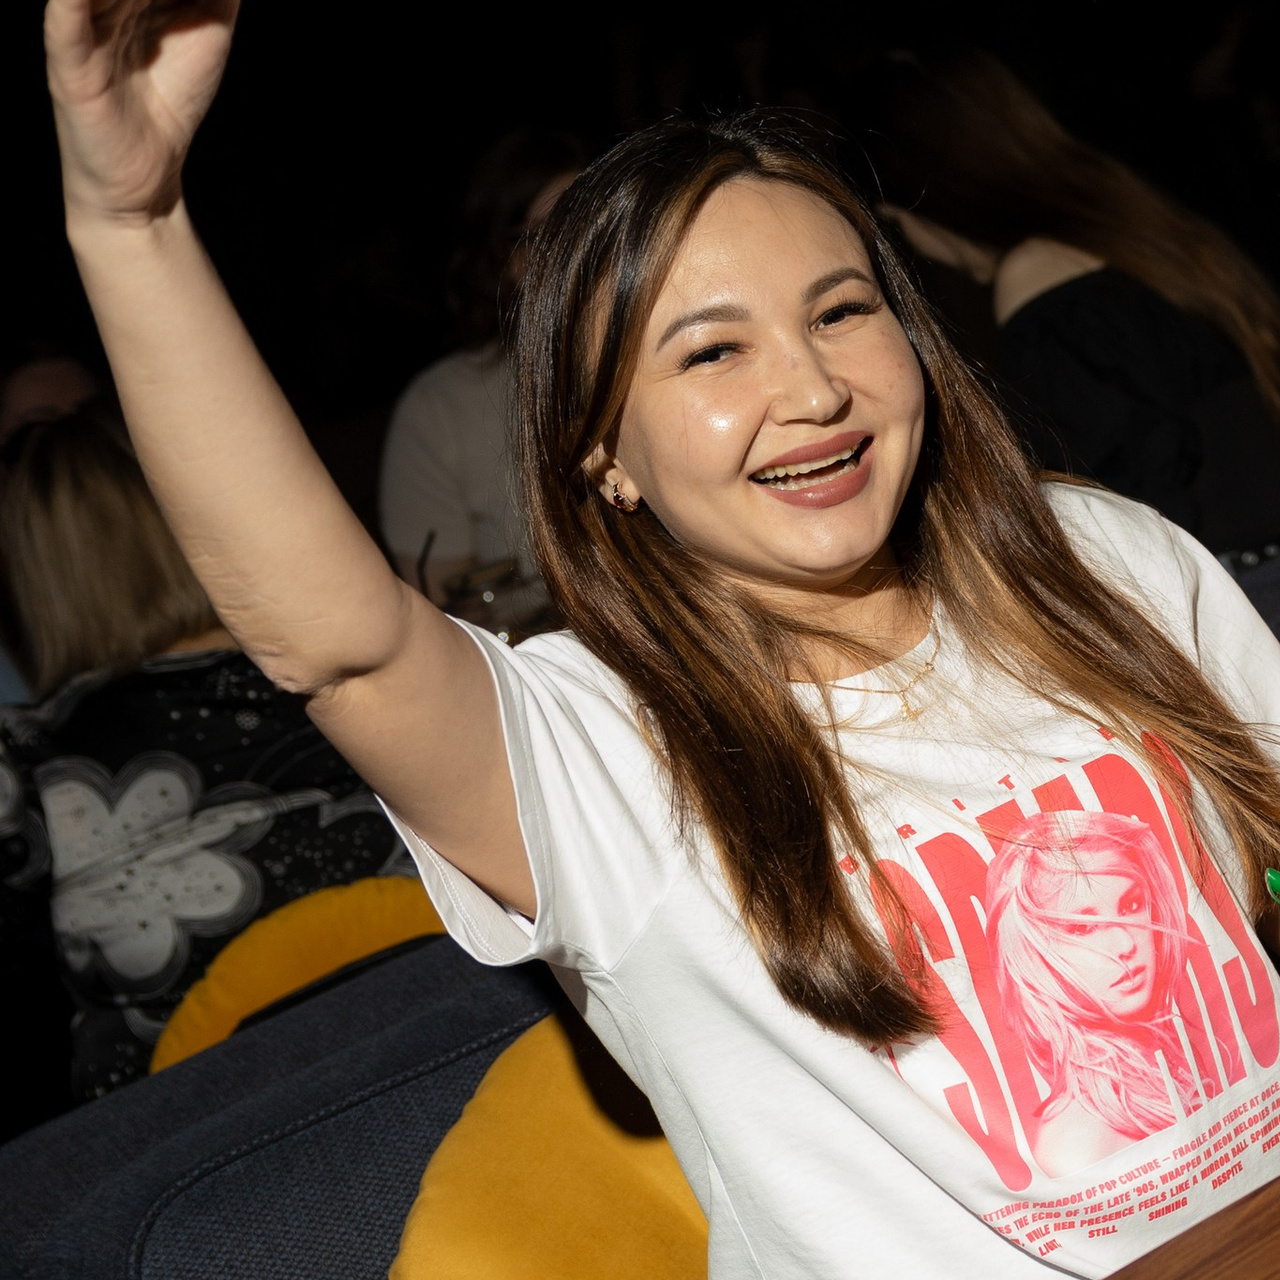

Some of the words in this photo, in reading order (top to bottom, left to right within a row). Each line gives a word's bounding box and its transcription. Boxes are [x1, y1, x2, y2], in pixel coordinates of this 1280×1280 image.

[1013, 1215, 1030, 1231] THE
[1032, 1211, 1061, 1223] ECHO
[1065, 1208, 1080, 1218] OF
[1083, 1201, 1104, 1216] THE
[1107, 1191, 1131, 1209] LATE
[1160, 1155, 1202, 1185] WRAPPED
[1203, 1147, 1212, 1161] IN
[1212, 1134, 1233, 1154] NEON
[1233, 1106, 1270, 1138] MELODIES
[1033, 1192, 1084, 1209] PARADOX
[1086, 1186, 1098, 1200] OF
[1099, 1179, 1117, 1194] POP
[1119, 1158, 1161, 1185] CULTURE
[1172, 1132, 1208, 1160] FRAGILE
[1207, 1121, 1223, 1140] AND
[1222, 1102, 1249, 1127] FIERCE
[1249, 1094, 1260, 1109] AT
[1053, 1221, 1076, 1233] HER
[1080, 1205, 1135, 1228] PRESENCE
[1138, 1191, 1167, 1212] FEELS
[1170, 1179, 1191, 1198] LIKE
[1192, 1174, 1199, 1186] A
[1200, 1153, 1231, 1181] MIRROR
[1231, 1139, 1249, 1158] BALL
[1088, 1225, 1118, 1239] STILL
[1148, 1196, 1188, 1222] SHINING
[1211, 1161, 1244, 1190] DESPITE
